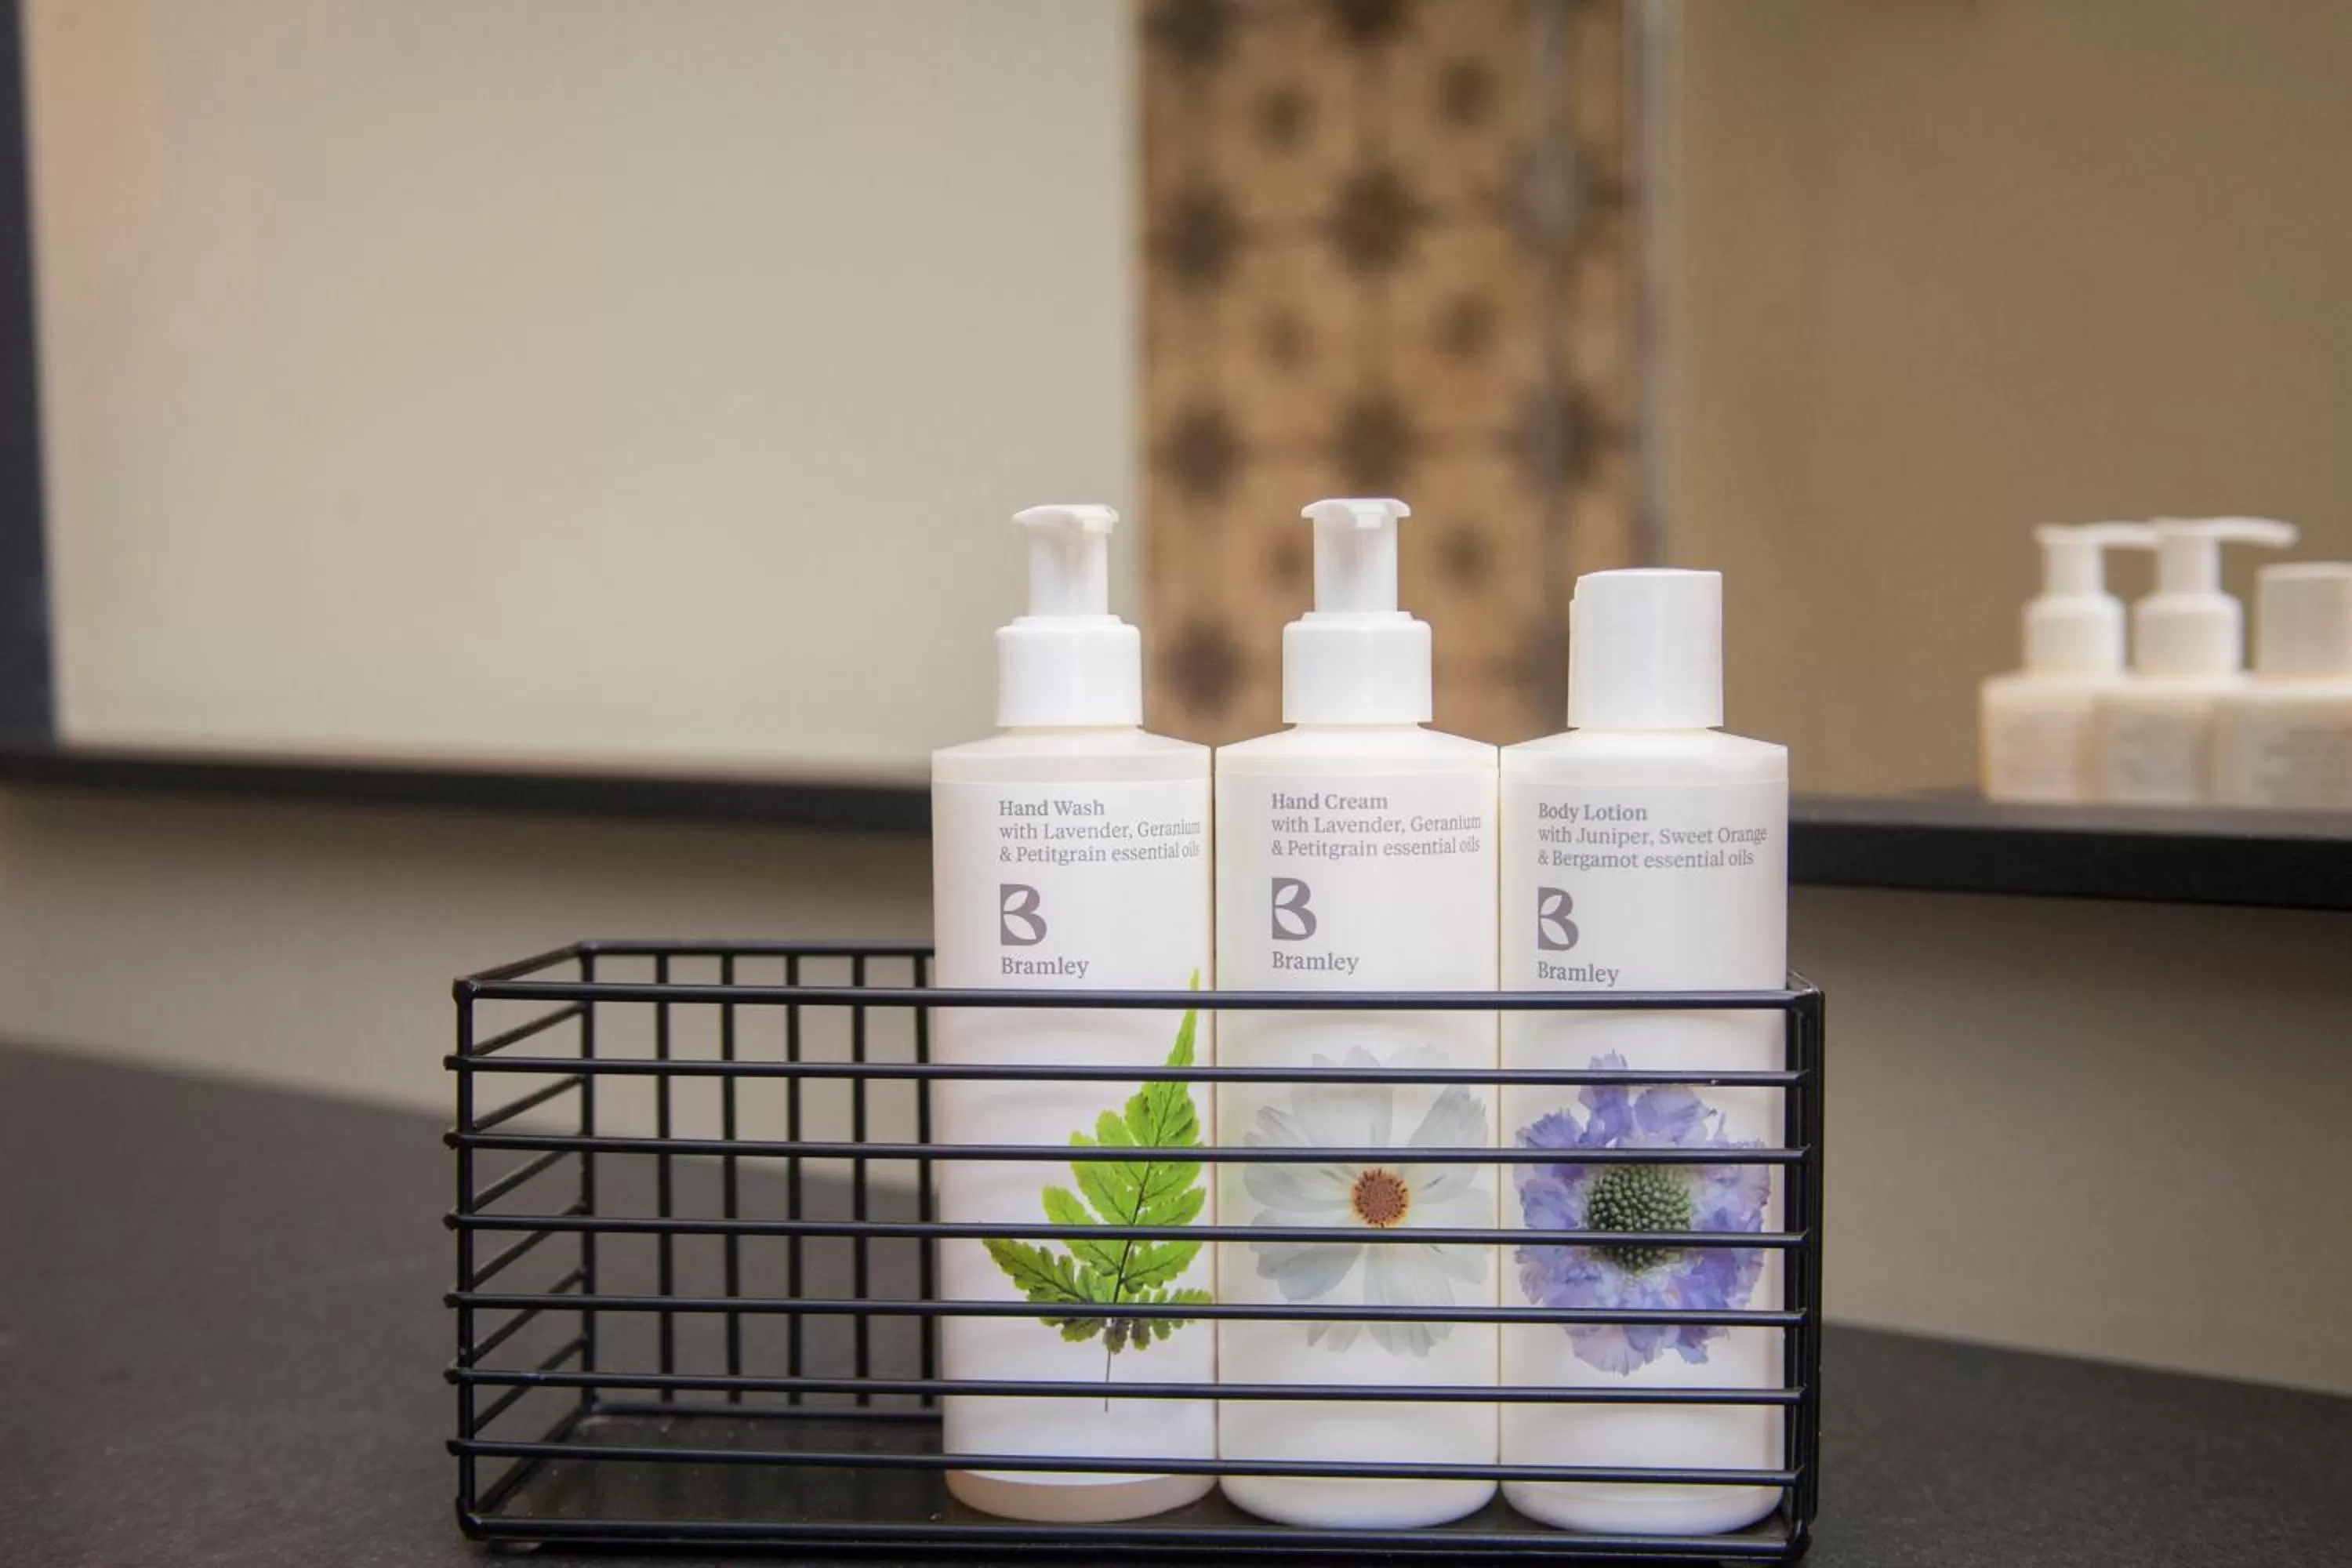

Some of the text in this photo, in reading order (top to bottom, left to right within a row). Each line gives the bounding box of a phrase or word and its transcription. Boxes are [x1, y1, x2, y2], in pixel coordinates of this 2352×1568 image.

[999, 800, 1105, 816] Hand Wash
[1272, 793, 1388, 810] Hand Cream
[1538, 803, 1648, 822] Body Lotion
[1000, 819, 1200, 840] with Lavender, Geranium
[1272, 815, 1481, 835] with Lavender, Geranium
[1272, 836, 1480, 860] & Petitgrain essential oils
[1538, 826, 1769, 848] with Juniper, Sweet Orange
[1000, 840, 1200, 866] & Petitgrain essential oils
[1538, 849, 1754, 870] & Bergamot essential oils
[1000, 884, 1047, 946] B
[1272, 877, 1317, 941] B
[1538, 887, 1578, 951] B
[1001, 956, 1090, 978] Bramley
[1272, 951, 1359, 975] Bramley
[1538, 961, 1619, 986] Bramley
